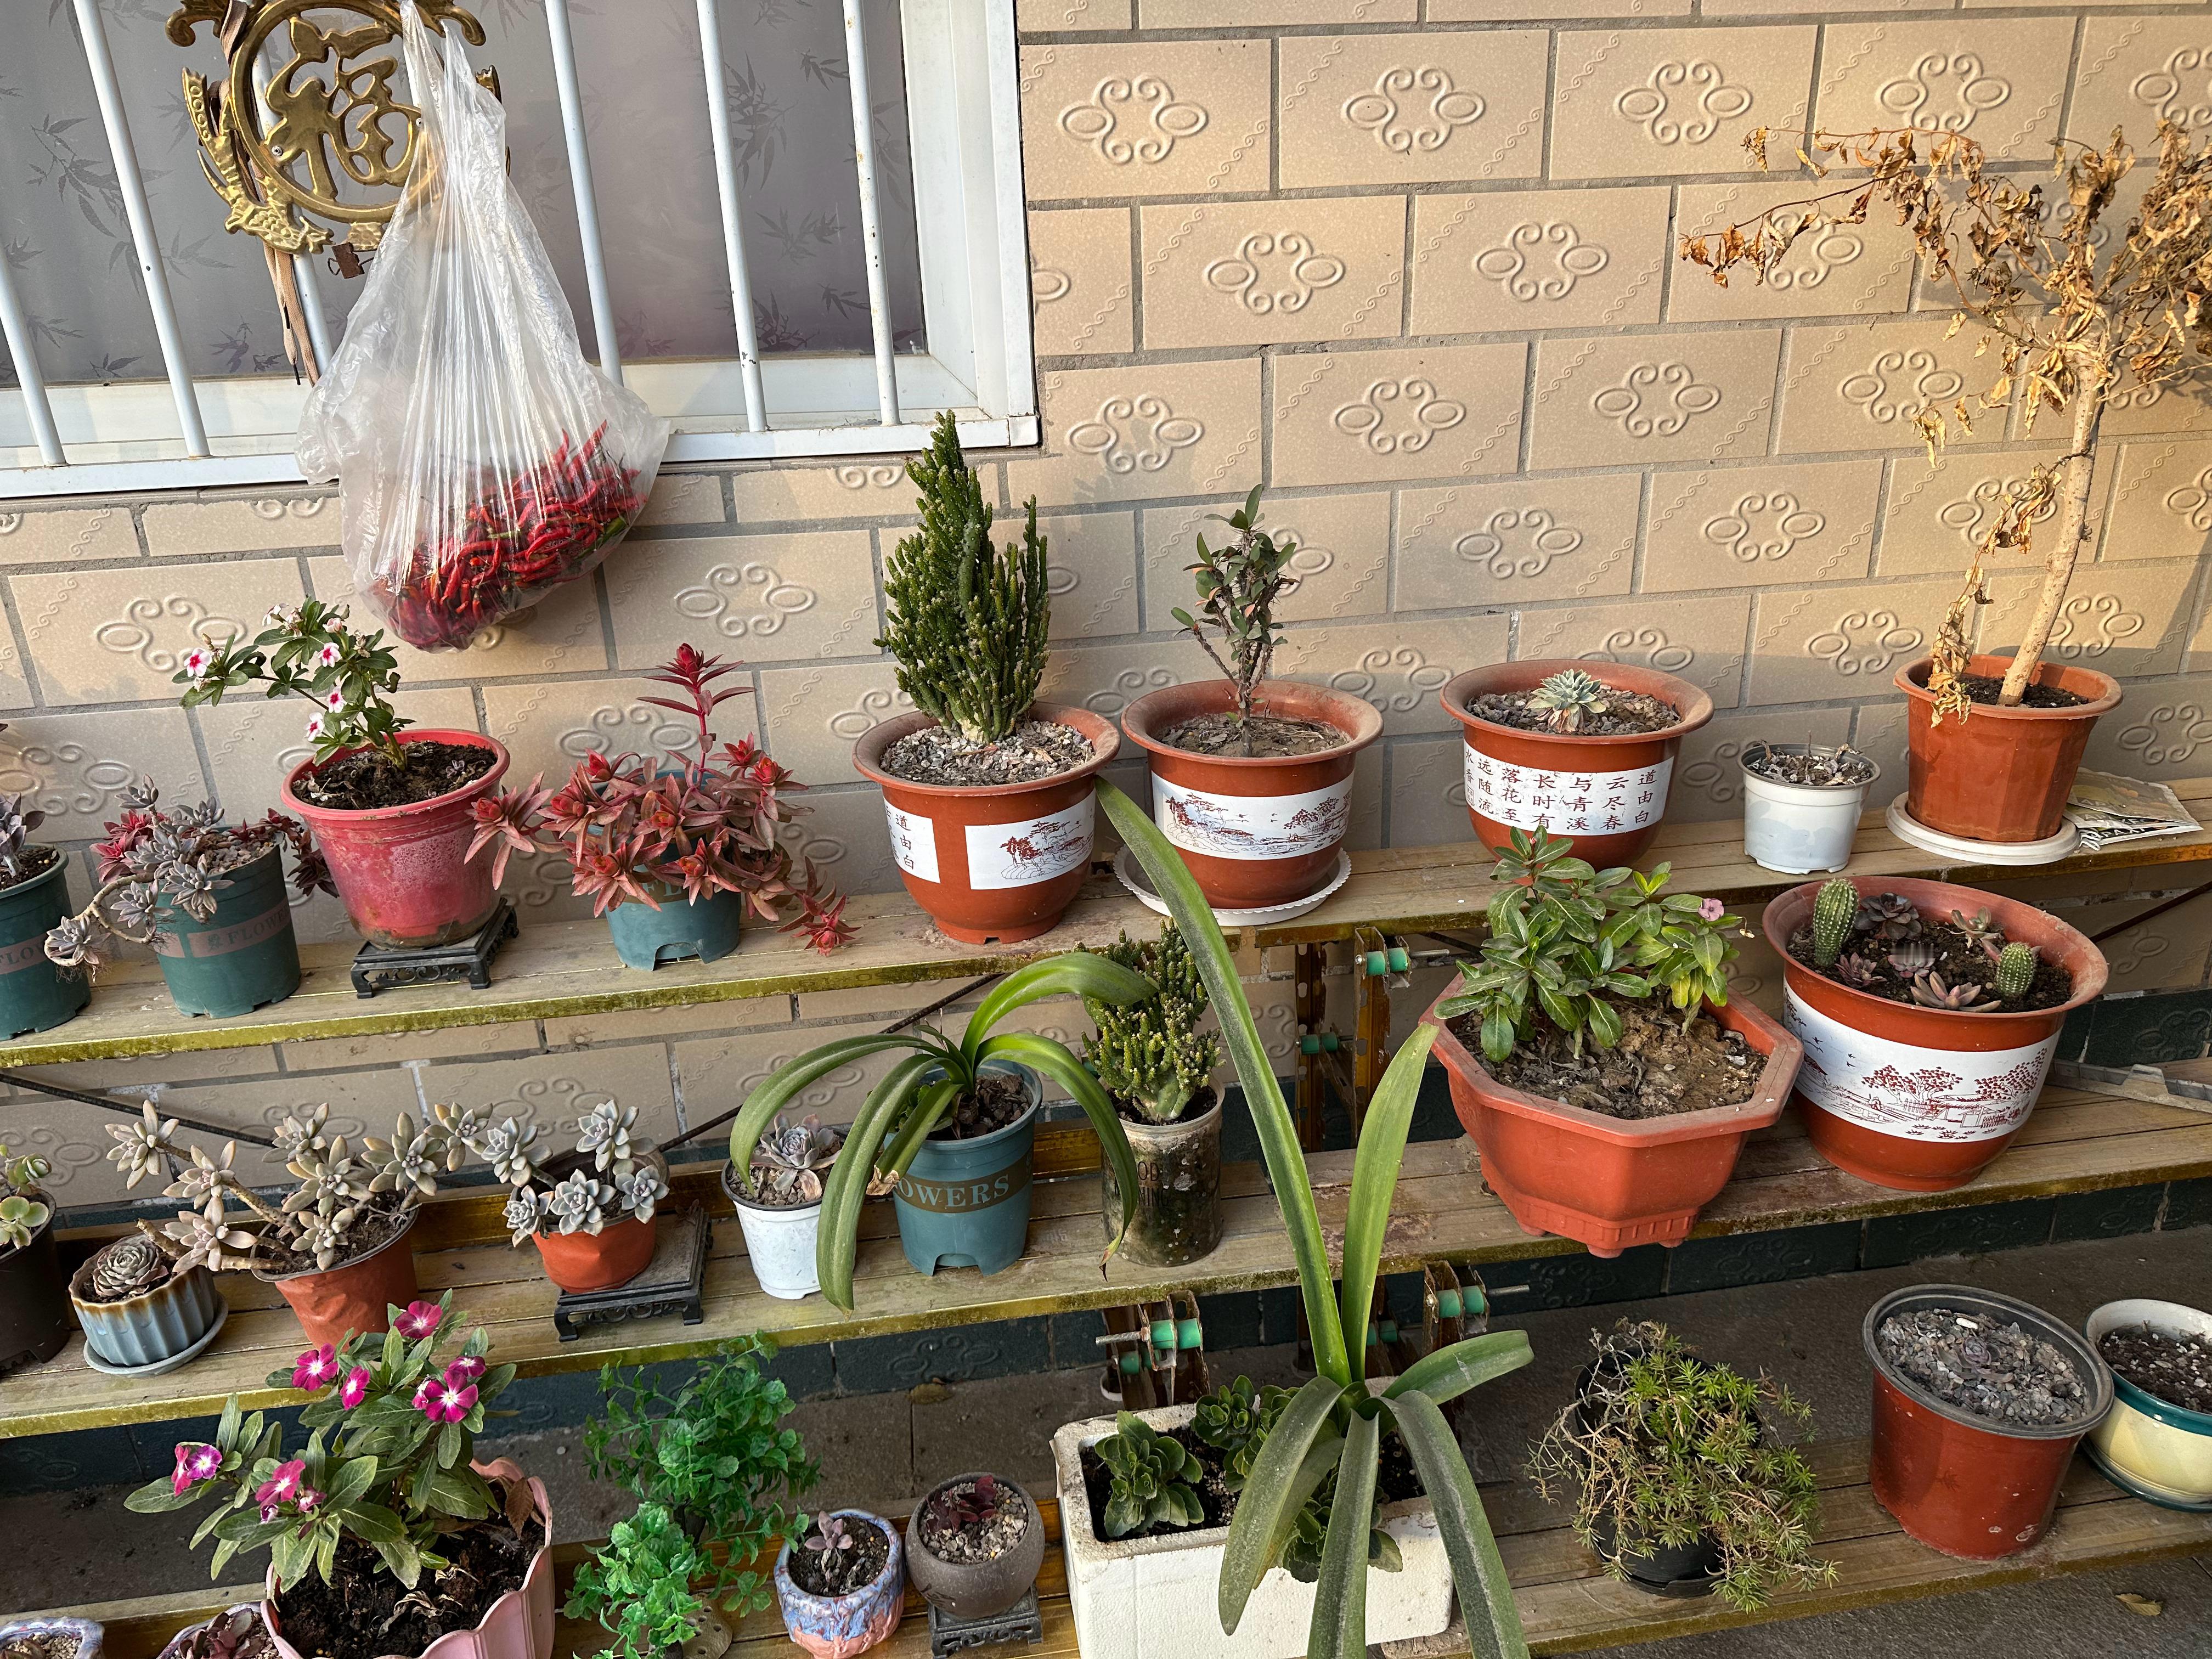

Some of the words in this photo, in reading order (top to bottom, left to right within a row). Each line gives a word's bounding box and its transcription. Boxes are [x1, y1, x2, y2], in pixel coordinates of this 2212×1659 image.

[1477, 758, 1494, 815] 远随流
[1500, 767, 1523, 823] 落花至
[1531, 774, 1556, 830] 长时有
[1566, 777, 1593, 831] 与青溪
[1600, 776, 1629, 831] 云尽春
[1635, 769, 1657, 824] 道由白
[895, 813, 914, 870] 道由白
[896, 1173, 1009, 1207] OWERS
